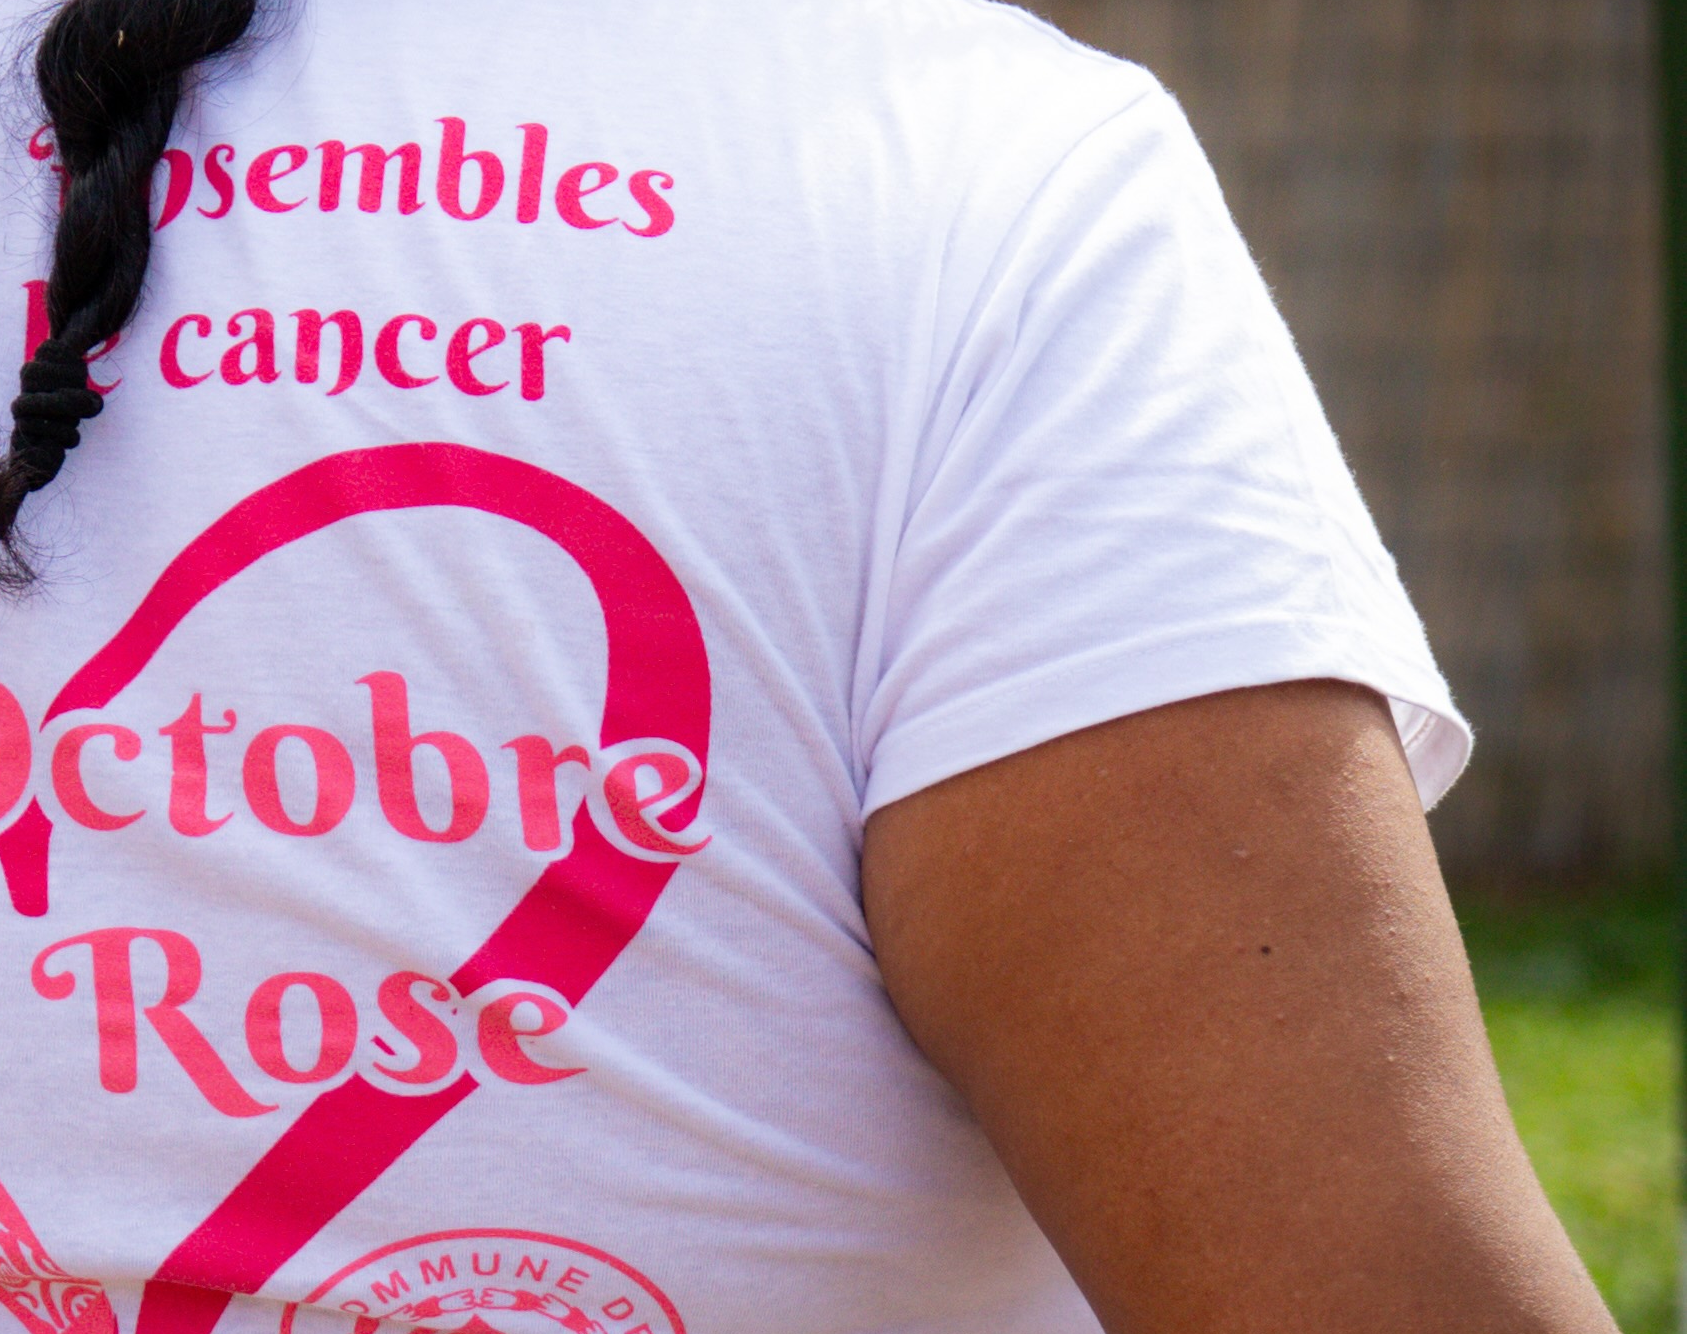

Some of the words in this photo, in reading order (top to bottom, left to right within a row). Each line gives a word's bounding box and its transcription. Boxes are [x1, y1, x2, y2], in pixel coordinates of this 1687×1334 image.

[29, 117, 676, 238] nsembles
[158, 307, 573, 402] cancer
[30, 926, 589, 1119] Rose
[339, 1251, 590, 1315] OMMUNE
